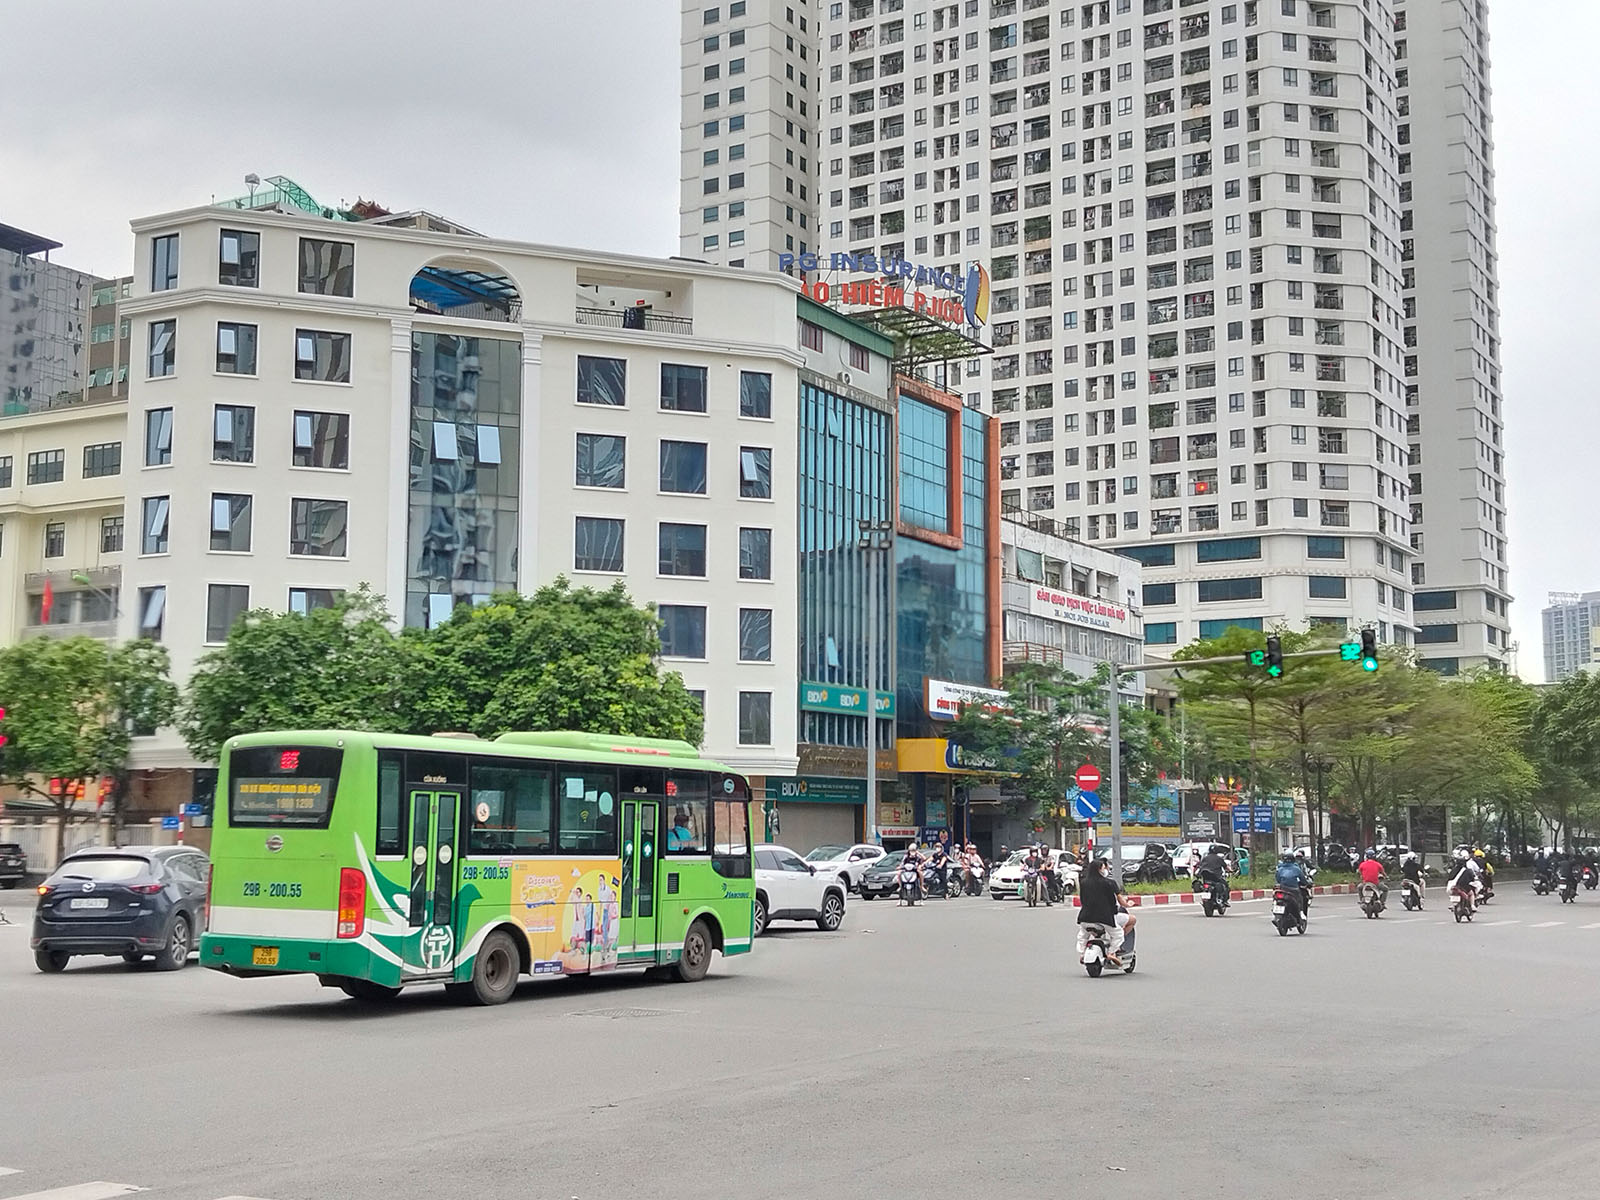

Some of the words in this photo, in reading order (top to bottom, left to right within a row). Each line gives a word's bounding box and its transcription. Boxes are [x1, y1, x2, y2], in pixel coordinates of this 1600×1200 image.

[779, 253, 817, 272] PG
[831, 253, 966, 296] INSURANCE
[800, 275, 829, 304] ẢO
[842, 277, 904, 308] HIỂM
[914, 291, 965, 325] PJICO
[1250, 650, 1265, 666] 12
[1340, 643, 1361, 660] 32
[807, 690, 824, 703] BIDV
[840, 694, 856, 707] BIDV
[782, 782, 800, 796] BIDV
[463, 866, 478, 880] 29B
[483, 866, 509, 880] 200.55
[243, 882, 260, 897] 29B
[269, 883, 302, 898] 200.55
